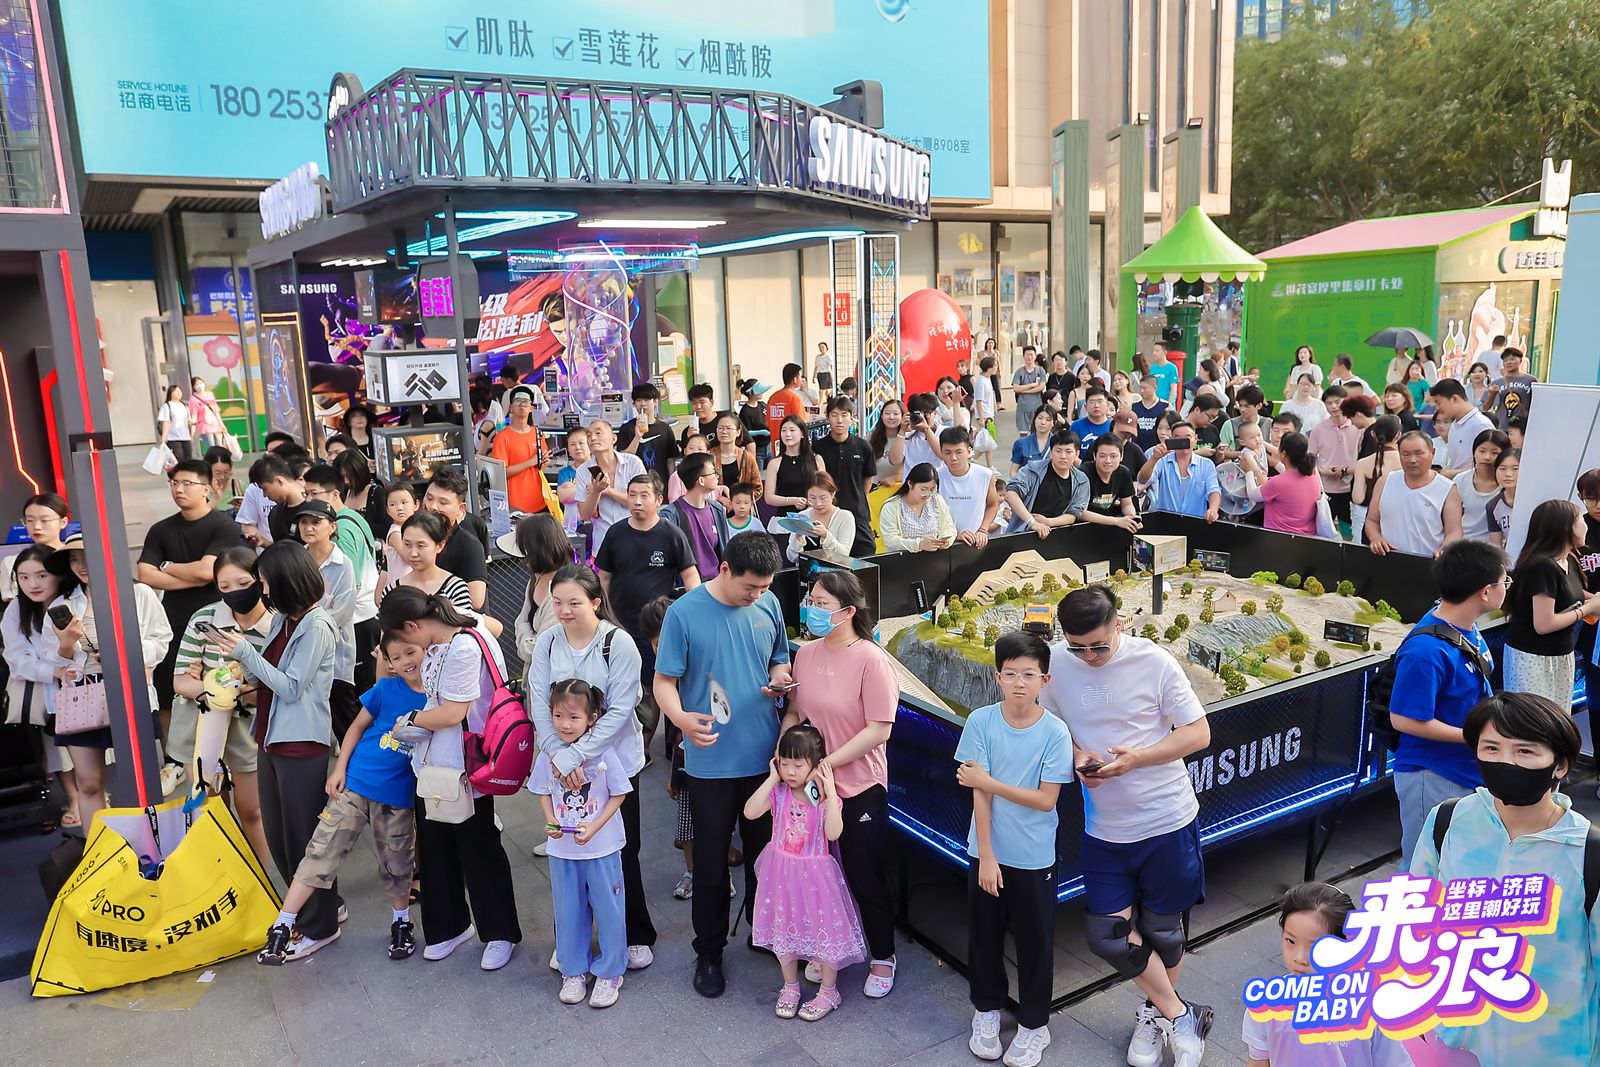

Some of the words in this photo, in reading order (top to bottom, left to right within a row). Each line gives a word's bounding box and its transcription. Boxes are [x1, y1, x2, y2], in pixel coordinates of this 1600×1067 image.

[475, 16, 535, 58] 肌肽
[578, 27, 661, 70] 雪莲花
[699, 38, 773, 79] 烟酰胺
[117, 80, 152, 91] SERVICE
[154, 83, 188, 94] HOTLINE
[119, 91, 191, 113] 招商电话
[210, 84, 261, 118] 180
[267, 88, 330, 121] 253
[891, 135, 971, 154] 大厦8908室
[809, 115, 931, 205] SAMSUNG
[479, 292, 509, 317] 级
[477, 311, 545, 342] 松胜利
[1187, 726, 1302, 794] MSUNG
[101, 899, 146, 922] PRO
